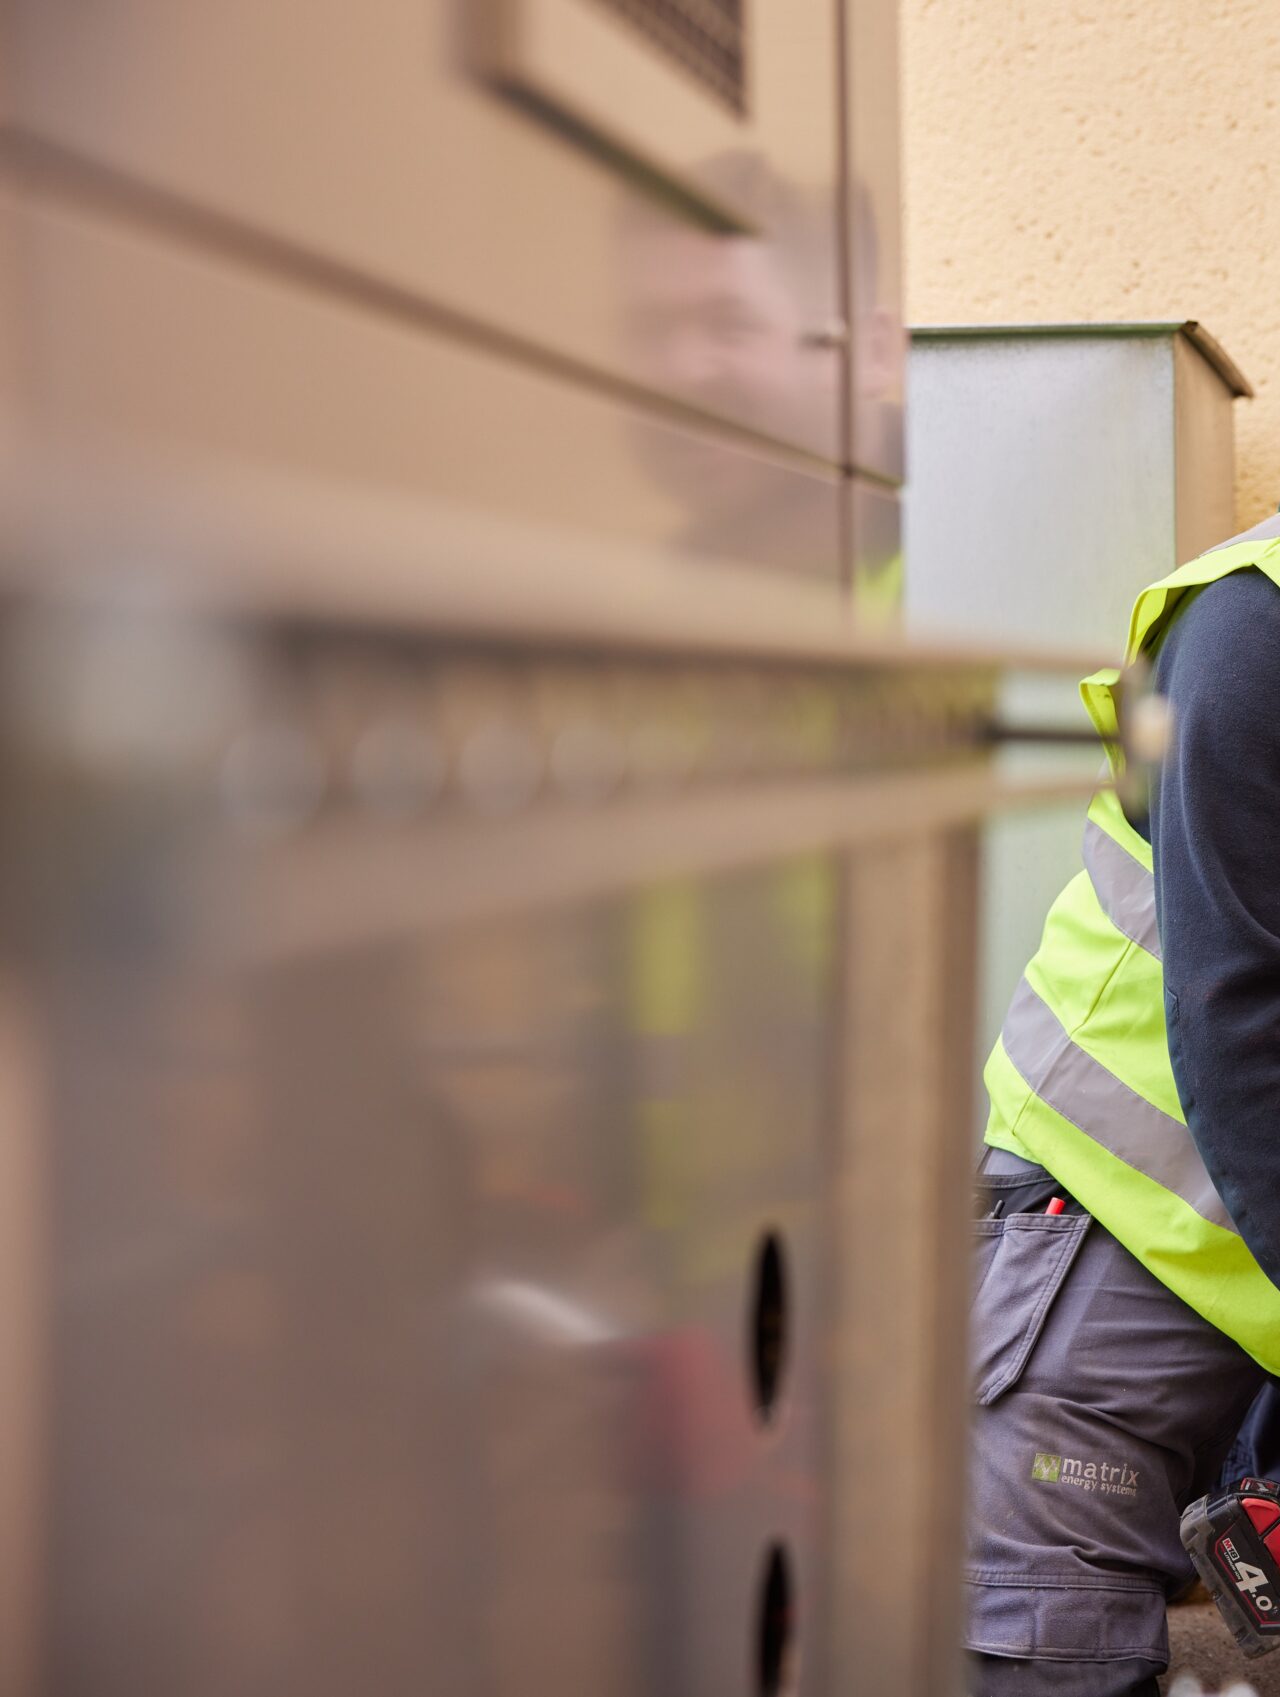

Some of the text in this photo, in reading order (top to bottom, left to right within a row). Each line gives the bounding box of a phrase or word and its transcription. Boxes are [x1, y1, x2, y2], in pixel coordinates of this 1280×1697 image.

[1062, 1458, 1140, 1486] matrix
[1061, 1475, 1136, 1496] energy systems
[1223, 1539, 1239, 1560] M18
[1234, 1561, 1273, 1612] 4.0
